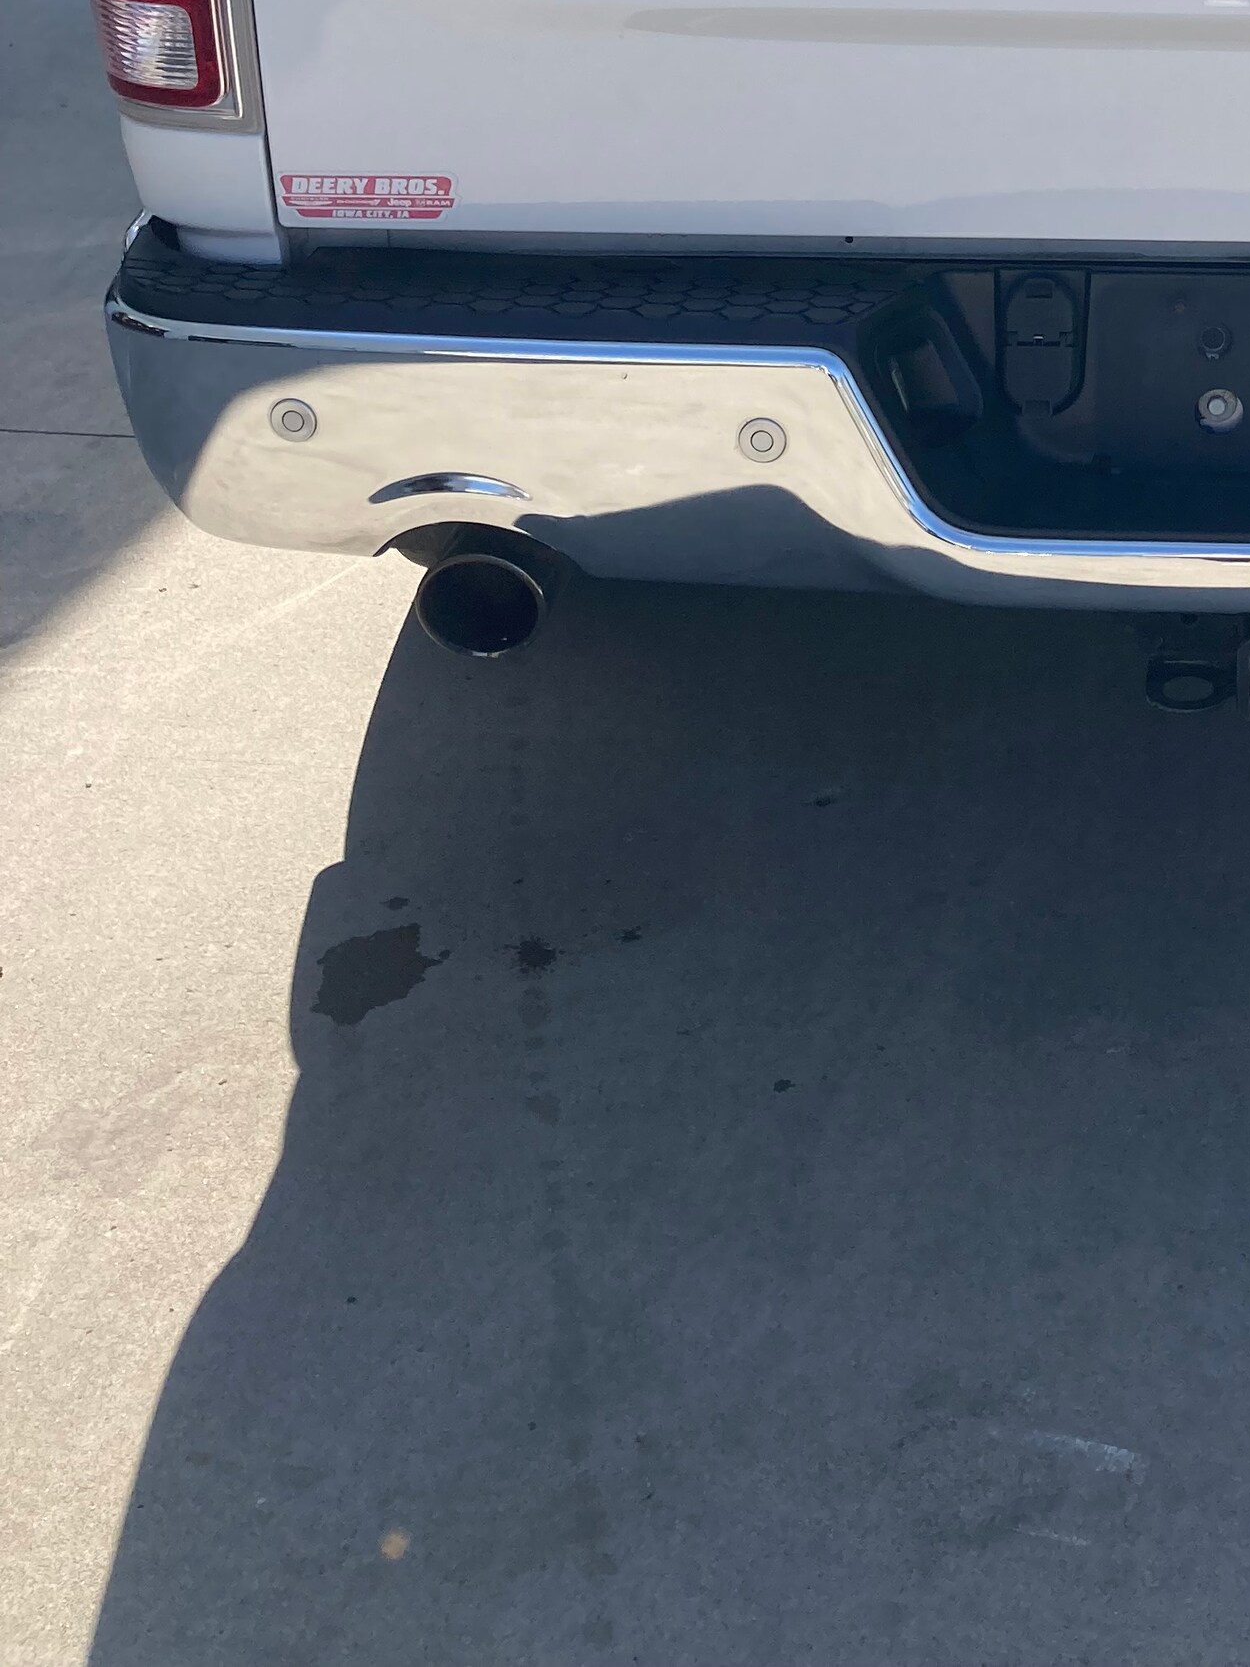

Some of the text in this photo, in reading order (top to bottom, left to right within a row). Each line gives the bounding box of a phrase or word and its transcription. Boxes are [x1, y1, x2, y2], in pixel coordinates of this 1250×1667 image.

[291, 177, 445, 195] DEERY BROS.
[387, 198, 411, 207] Jeep
[332, 210, 410, 219] IOWA CITY, IA
